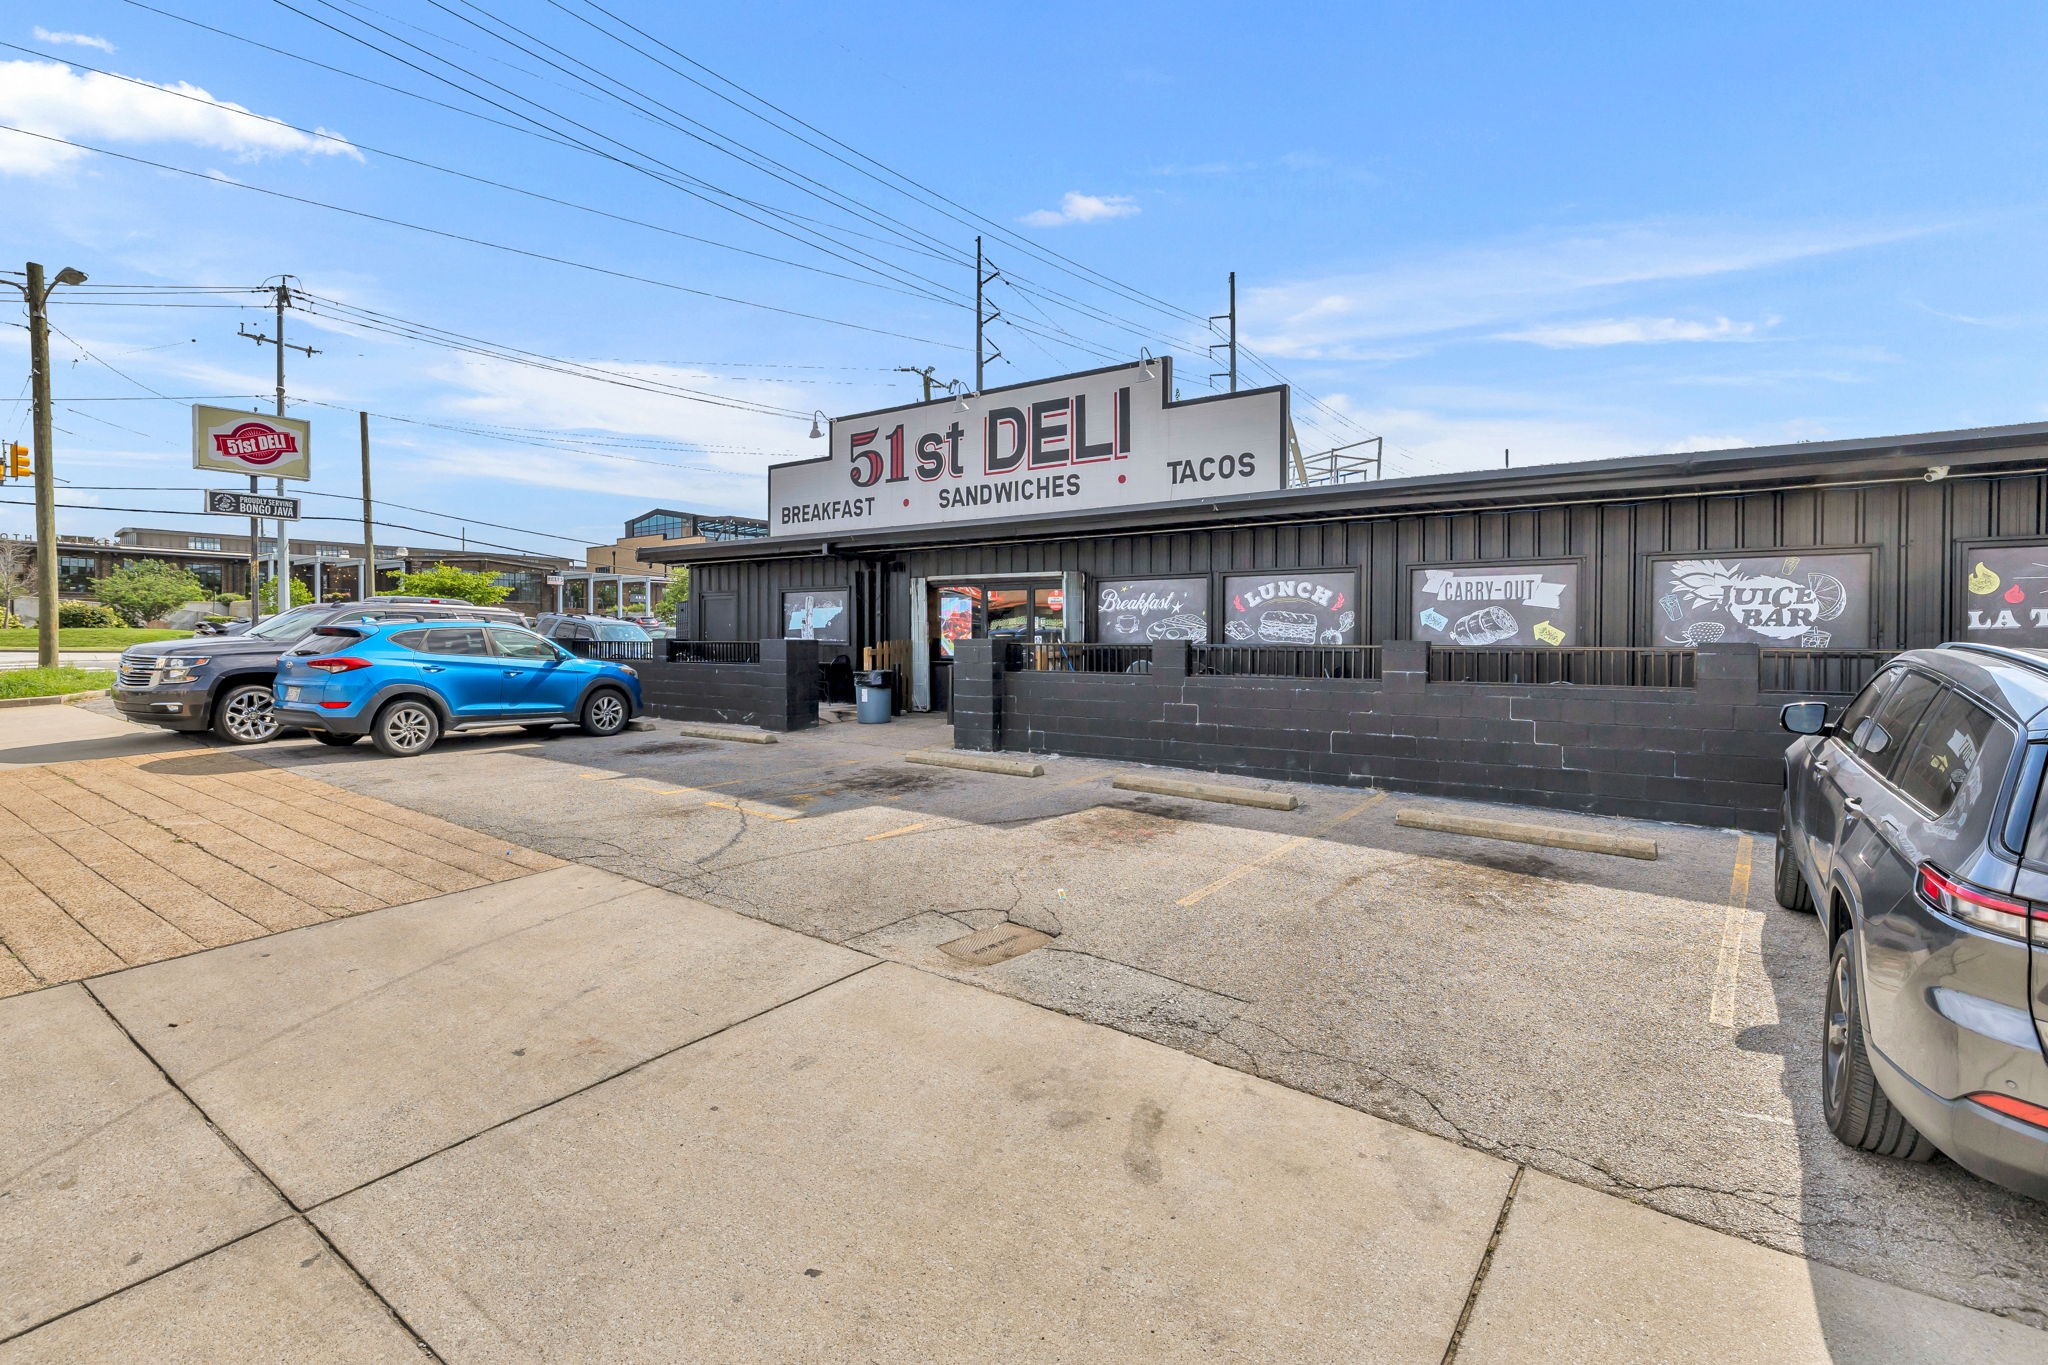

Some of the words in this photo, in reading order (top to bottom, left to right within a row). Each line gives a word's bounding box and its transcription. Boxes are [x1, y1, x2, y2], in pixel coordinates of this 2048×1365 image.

[226, 437, 257, 455] 51st
[258, 434, 287, 452] DELI
[849, 421, 965, 488] 51st
[984, 386, 1131, 477] DELI
[781, 496, 876, 525] BREAKFAST
[938, 473, 1081, 509] SANDWICHES
[1166, 452, 1256, 485] TACOS
[239, 495, 268, 506] PROUDLY
[268, 498, 294, 508] SERVING
[239, 503, 271, 515] BONGO
[272, 506, 294, 517] JAVA
[1243, 580, 1334, 608] LUNCH
[1444, 579, 1536, 601] CARRY-OUT
[1717, 584, 1815, 609] JUICE
[1098, 588, 1175, 616] Breakfast
[1741, 606, 1814, 628] BAR
[1967, 609, 2022, 631] LA
